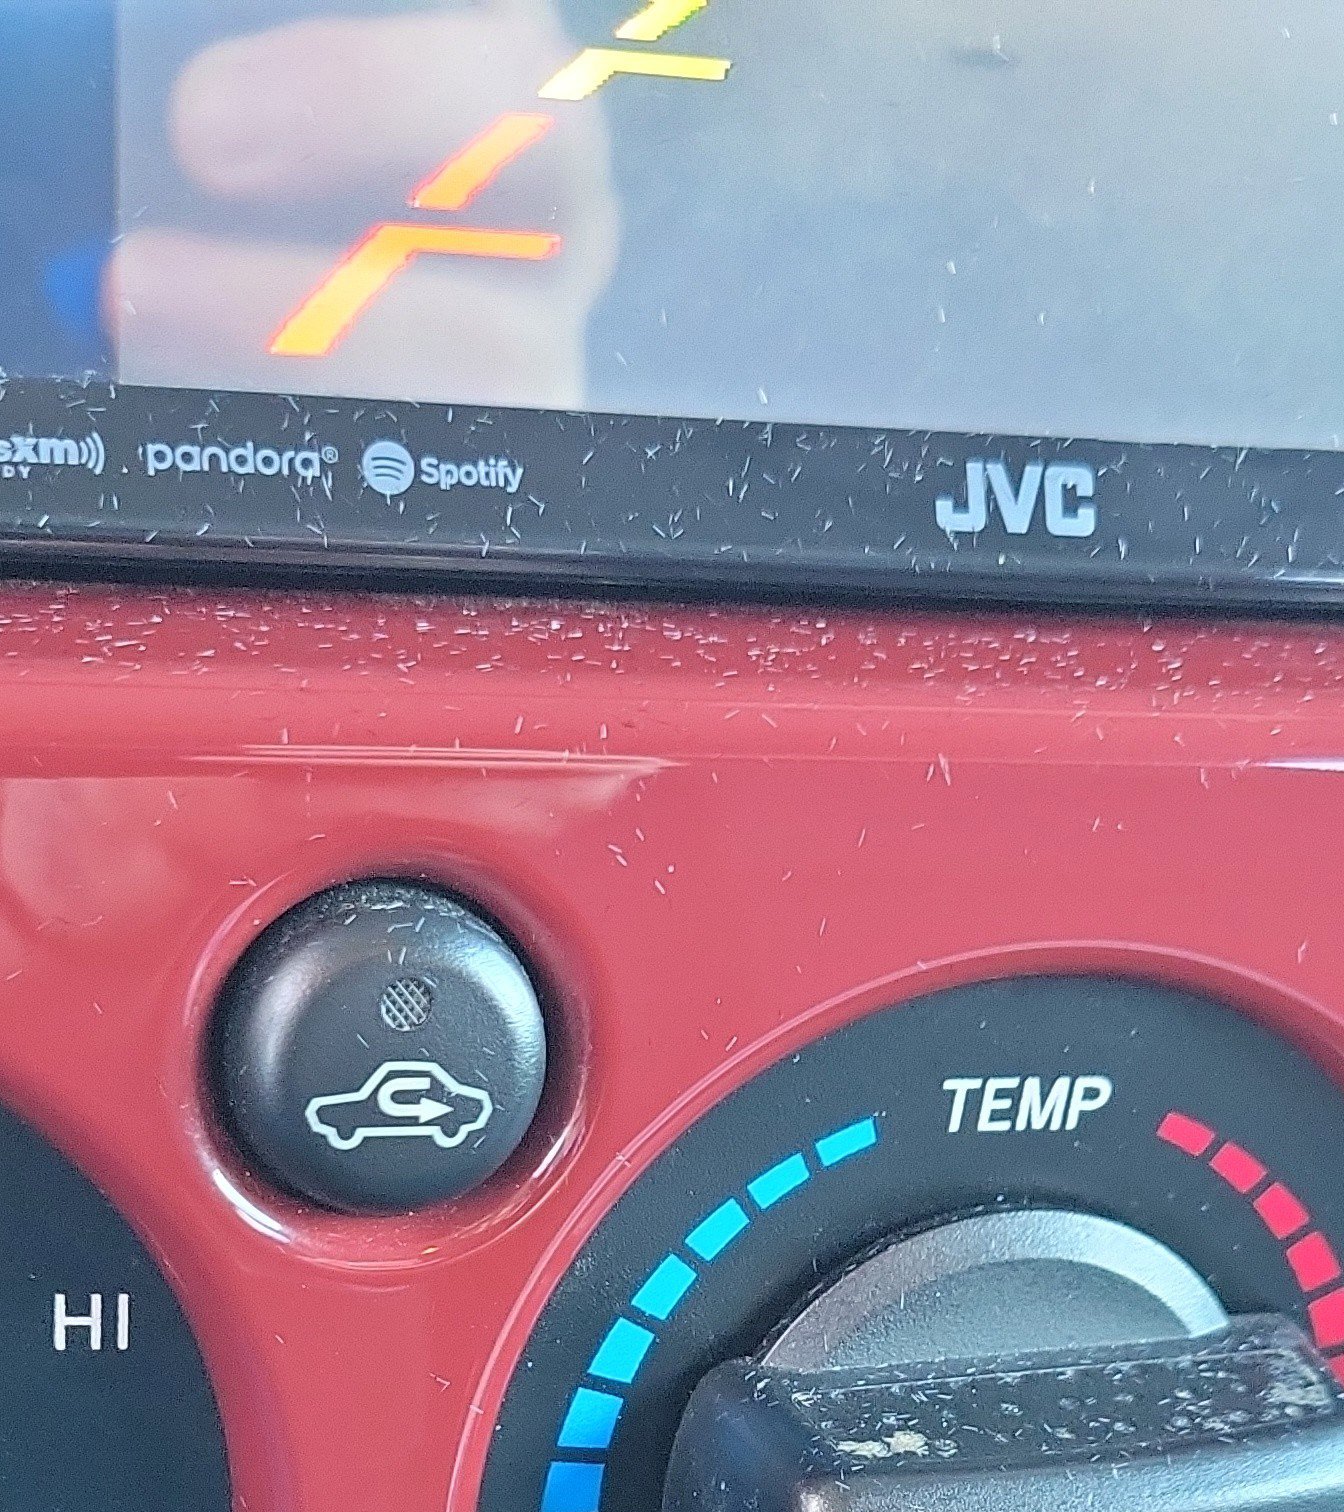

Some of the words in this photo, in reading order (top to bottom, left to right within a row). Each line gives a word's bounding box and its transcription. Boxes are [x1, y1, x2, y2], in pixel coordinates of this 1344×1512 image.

[420, 456, 524, 494] Spotify
[935, 458, 1096, 537] JVC
[942, 1075, 1113, 1133] TEMP
[52, 1292, 131, 1352] HI
